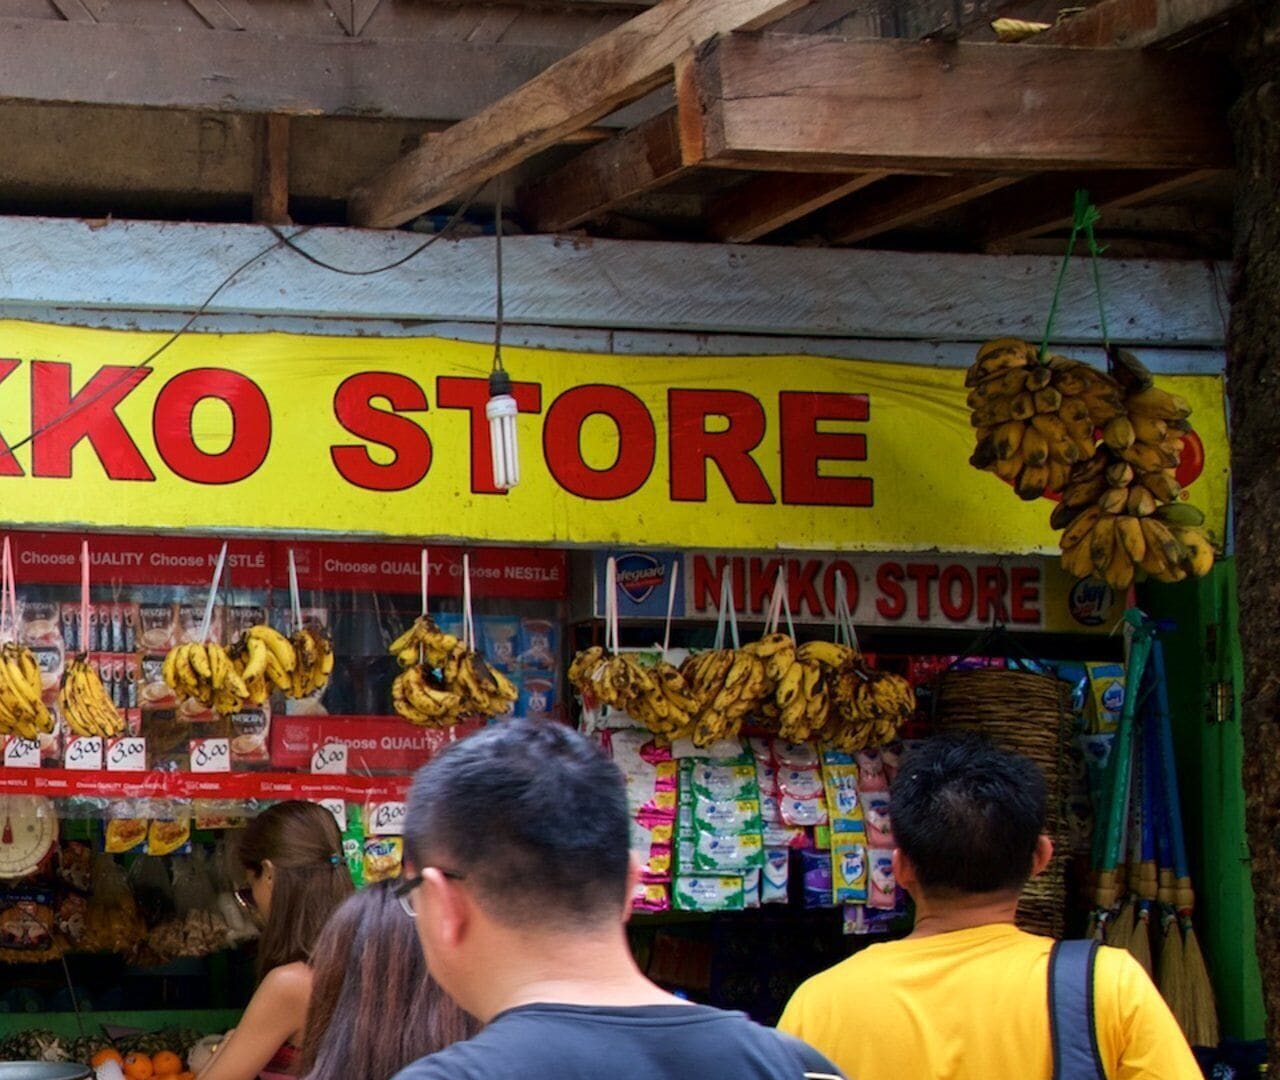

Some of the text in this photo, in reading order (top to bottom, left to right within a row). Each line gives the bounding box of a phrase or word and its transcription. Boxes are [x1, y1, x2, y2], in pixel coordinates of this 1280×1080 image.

[330, 370, 875, 508] STORE
[20, 550, 75, 566] Choose
[80, 551, 143, 566] UALITY
[150, 553, 205, 568] Choose
[207, 551, 266, 569] NSTLÉ
[324, 559, 377, 574] Choose
[380, 560, 443, 575] QUALTY
[504, 564, 560, 581] NESTLÉ
[615, 564, 665, 583] afeguard
[693, 554, 1042, 624] NIKKO STORE
[70, 740, 101, 762] 3.00
[111, 741, 144, 764] 3.00
[194, 741, 228, 767] 8.00
[314, 749, 345, 771] 8.00
[375, 804, 407, 829] 13.00
